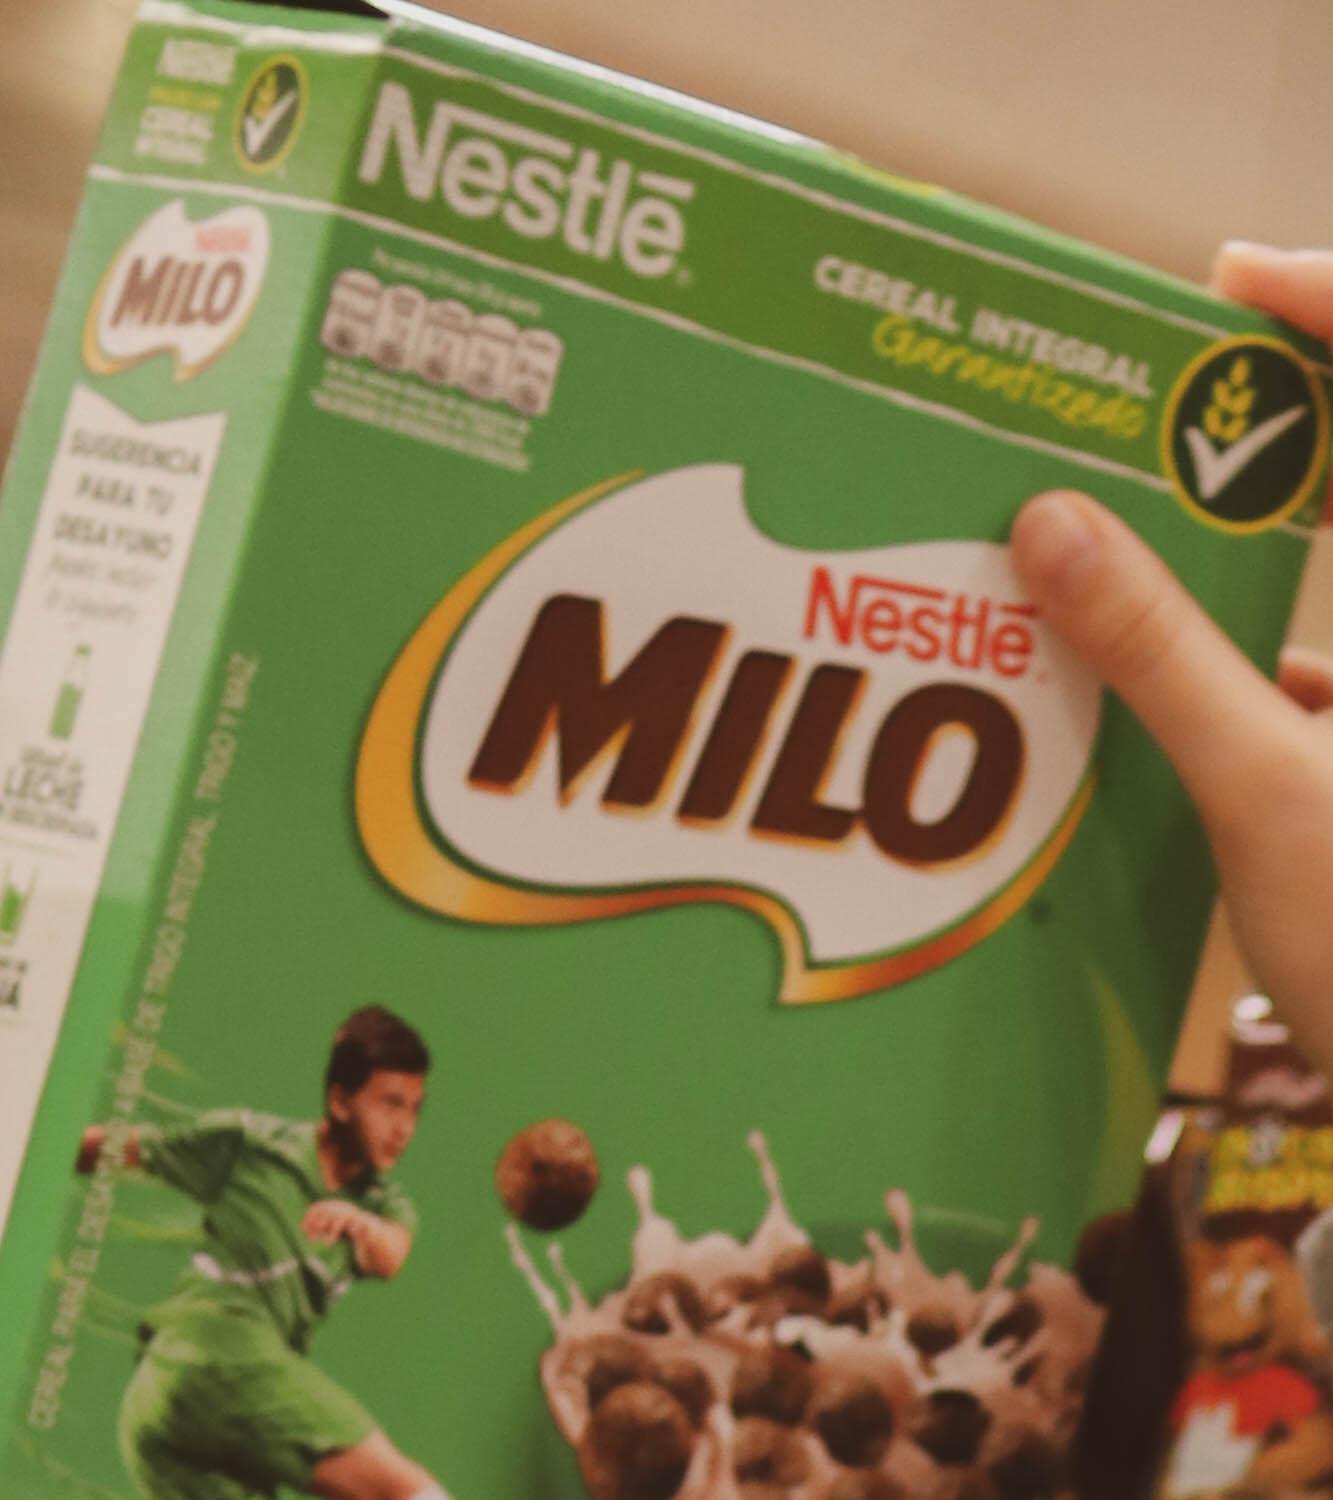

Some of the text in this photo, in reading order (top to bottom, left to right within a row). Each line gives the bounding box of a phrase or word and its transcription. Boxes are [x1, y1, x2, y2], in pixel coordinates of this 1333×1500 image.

[359, 81, 696, 277] Nestlé
[110, 256, 245, 328] MILO
[814, 255, 1154, 399] CEREAL INTEGRAL
[77, 473, 137, 508] PARA
[803, 565, 1042, 678] Nestlé
[467, 593, 1027, 874] MILO
